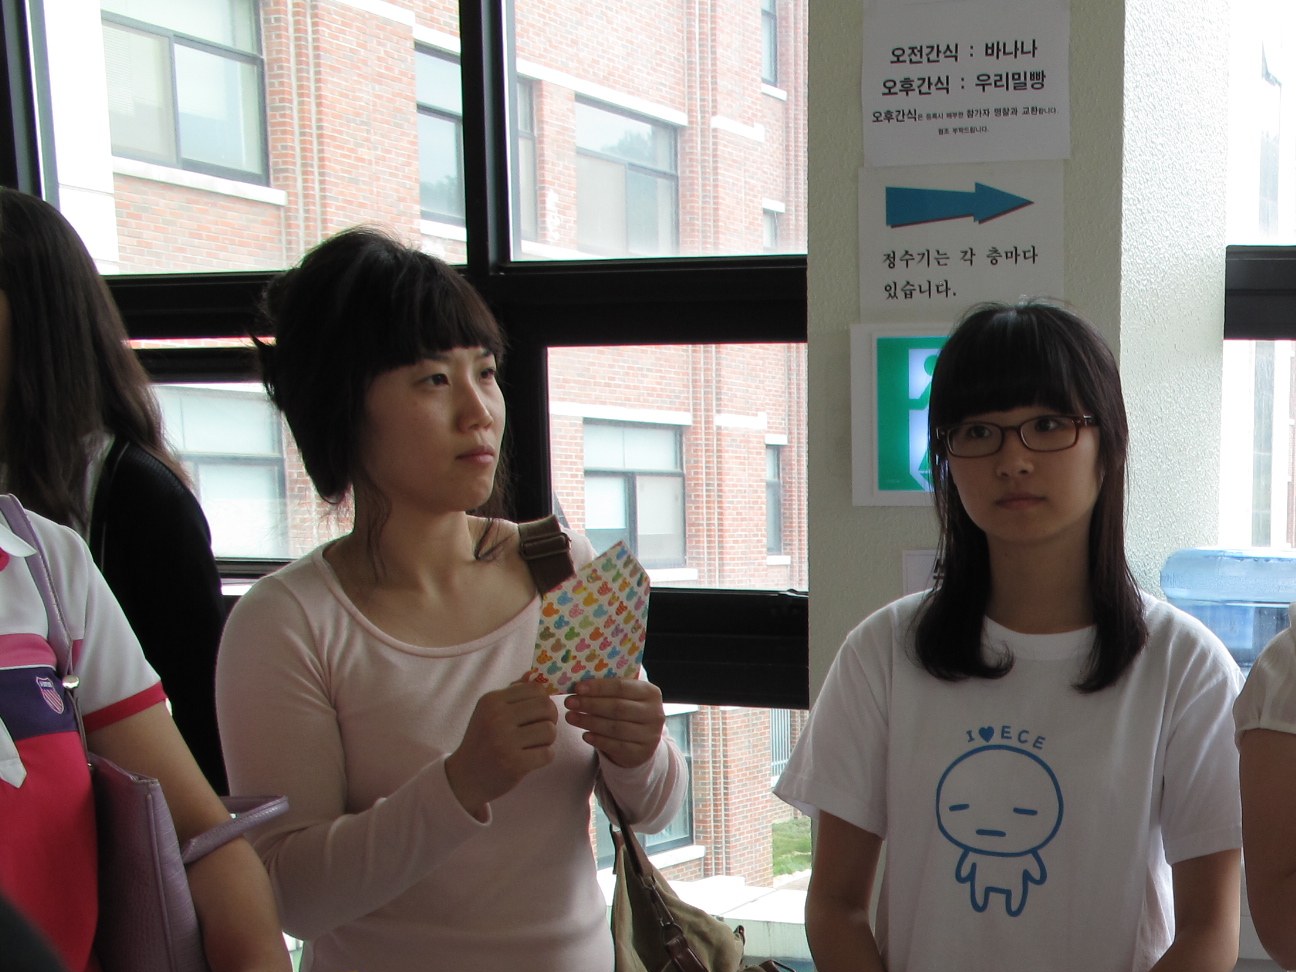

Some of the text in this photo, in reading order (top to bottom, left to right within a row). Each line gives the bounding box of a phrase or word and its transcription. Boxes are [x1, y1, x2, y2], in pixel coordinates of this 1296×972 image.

[890, 43, 959, 64] 오전간식
[985, 39, 1038, 60] 바나나
[881, 75, 950, 96] 오후간식
[975, 70, 1046, 92] 우리밀빵
[966, 108, 990, 119] 참가자
[994, 107, 1018, 117] 명찰과
[883, 245, 1038, 269] 정수기는 각 층마다
[884, 280, 957, 300] 있습니다.
[1000, 725, 1046, 750] ECE
